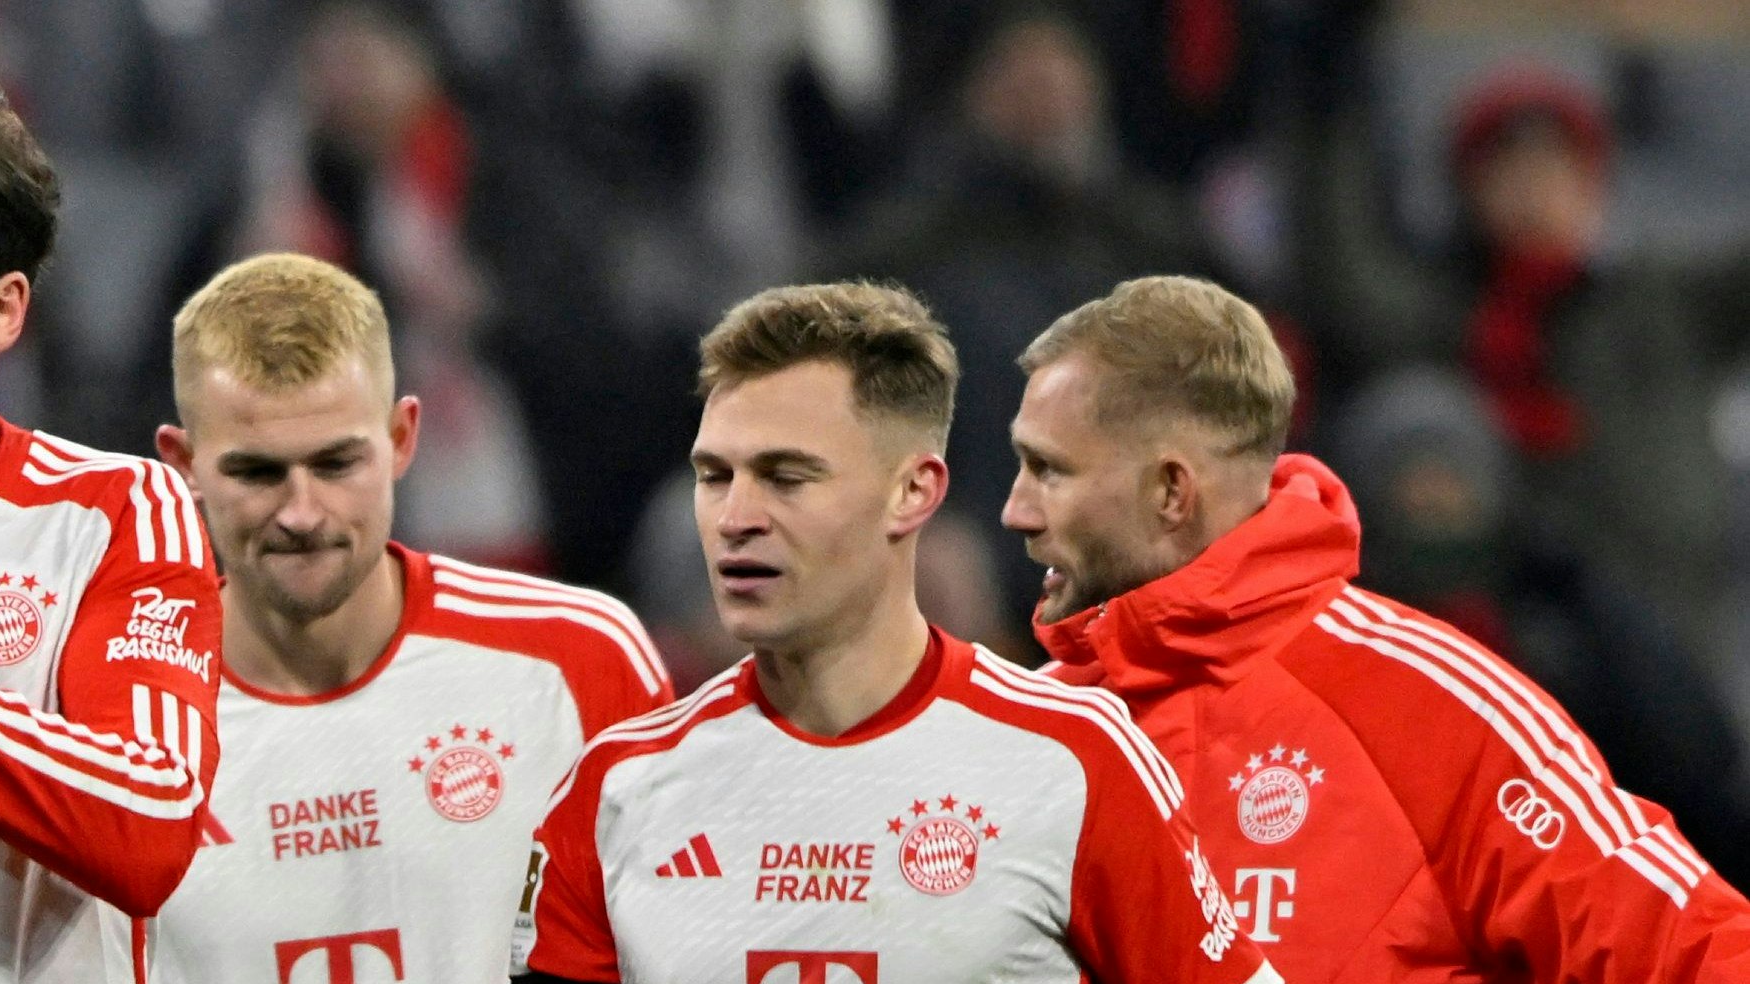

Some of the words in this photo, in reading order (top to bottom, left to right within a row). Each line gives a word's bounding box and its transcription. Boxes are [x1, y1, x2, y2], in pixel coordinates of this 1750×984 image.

[126, 616, 189, 647] GEGEN
[106, 636, 213, 684] RASSISMUS
[1259, 773, 1301, 799] BAYERN
[269, 788, 378, 829] DANKE
[273, 819, 383, 861] FRANZ
[760, 843, 875, 869] DANKE
[925, 822, 976, 856] BAYERN
[755, 874, 870, 902] FRANZ
[1233, 867, 1296, 942] T
